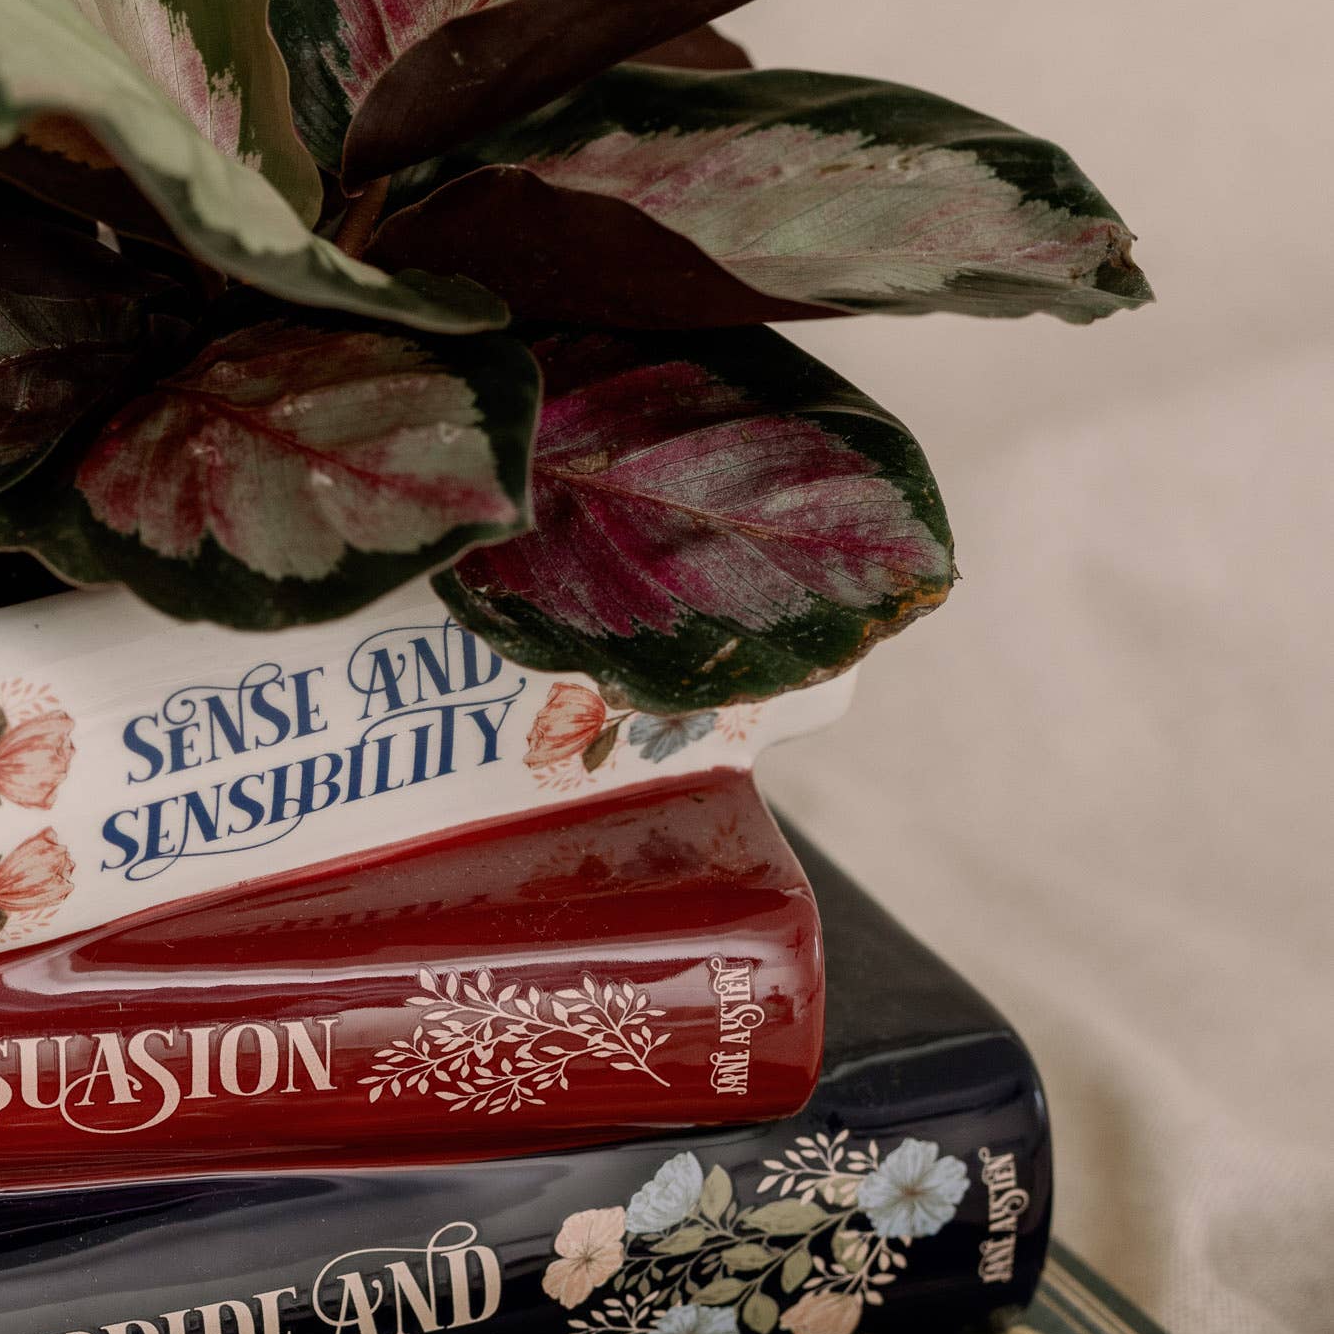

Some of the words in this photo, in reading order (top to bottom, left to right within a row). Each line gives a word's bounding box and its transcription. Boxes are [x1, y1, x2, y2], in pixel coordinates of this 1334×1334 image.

[122, 663, 328, 785] SENSE
[347, 616, 504, 721] AND
[100, 676, 527, 881] SENSIBILITY
[711, 957, 765, 1046] AUSTEN
[710, 1050, 751, 1096] JANE
[978, 1146, 1030, 1232] AUSTEN
